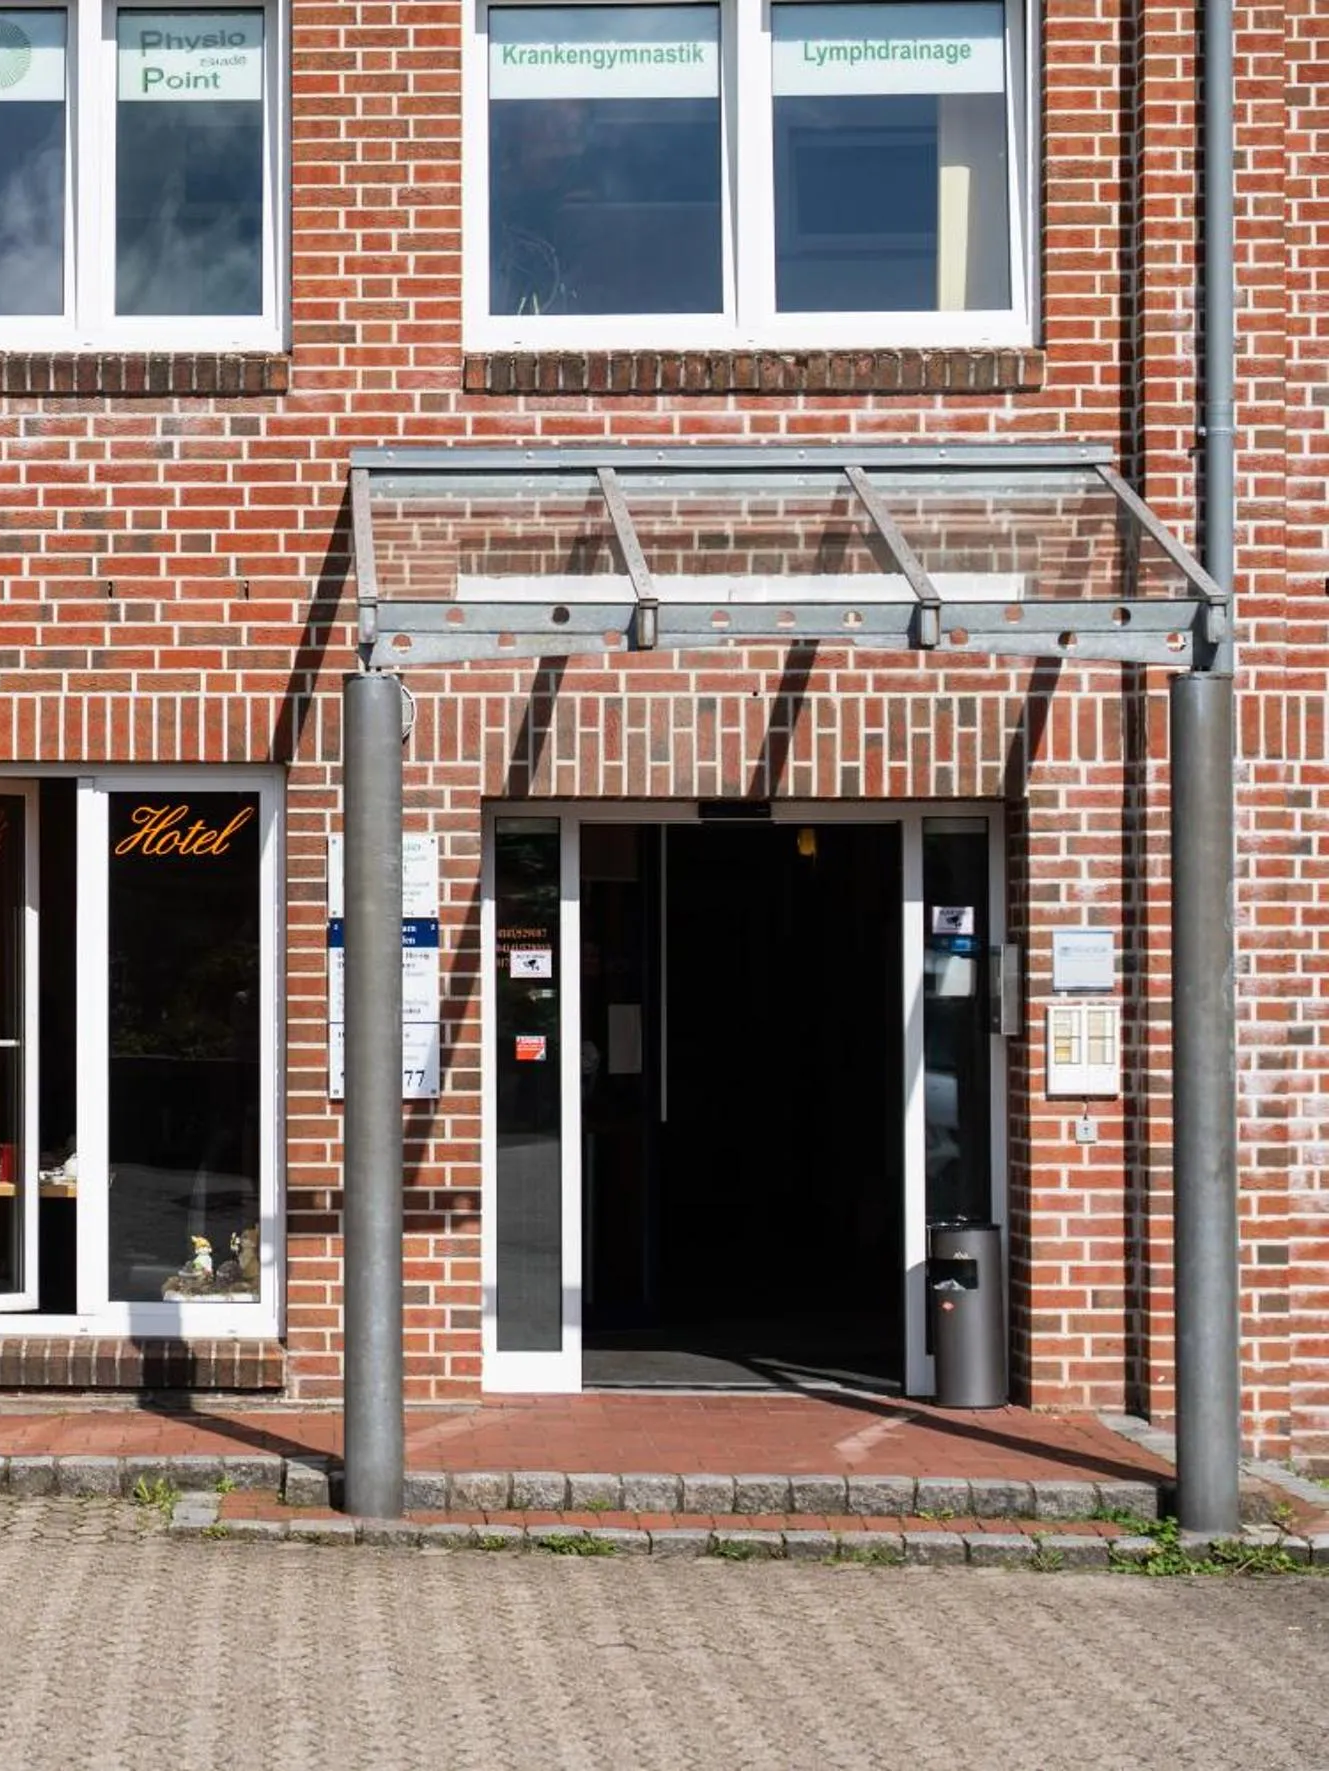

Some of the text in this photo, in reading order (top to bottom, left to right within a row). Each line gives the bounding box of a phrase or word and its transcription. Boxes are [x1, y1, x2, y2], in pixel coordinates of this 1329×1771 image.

[139, 29, 246, 57] Physio
[501, 42, 705, 68] Krankengymnastik
[802, 39, 972, 66] Lymphdrainage
[142, 66, 221, 94] Point
[114, 804, 254, 856] Hotel
